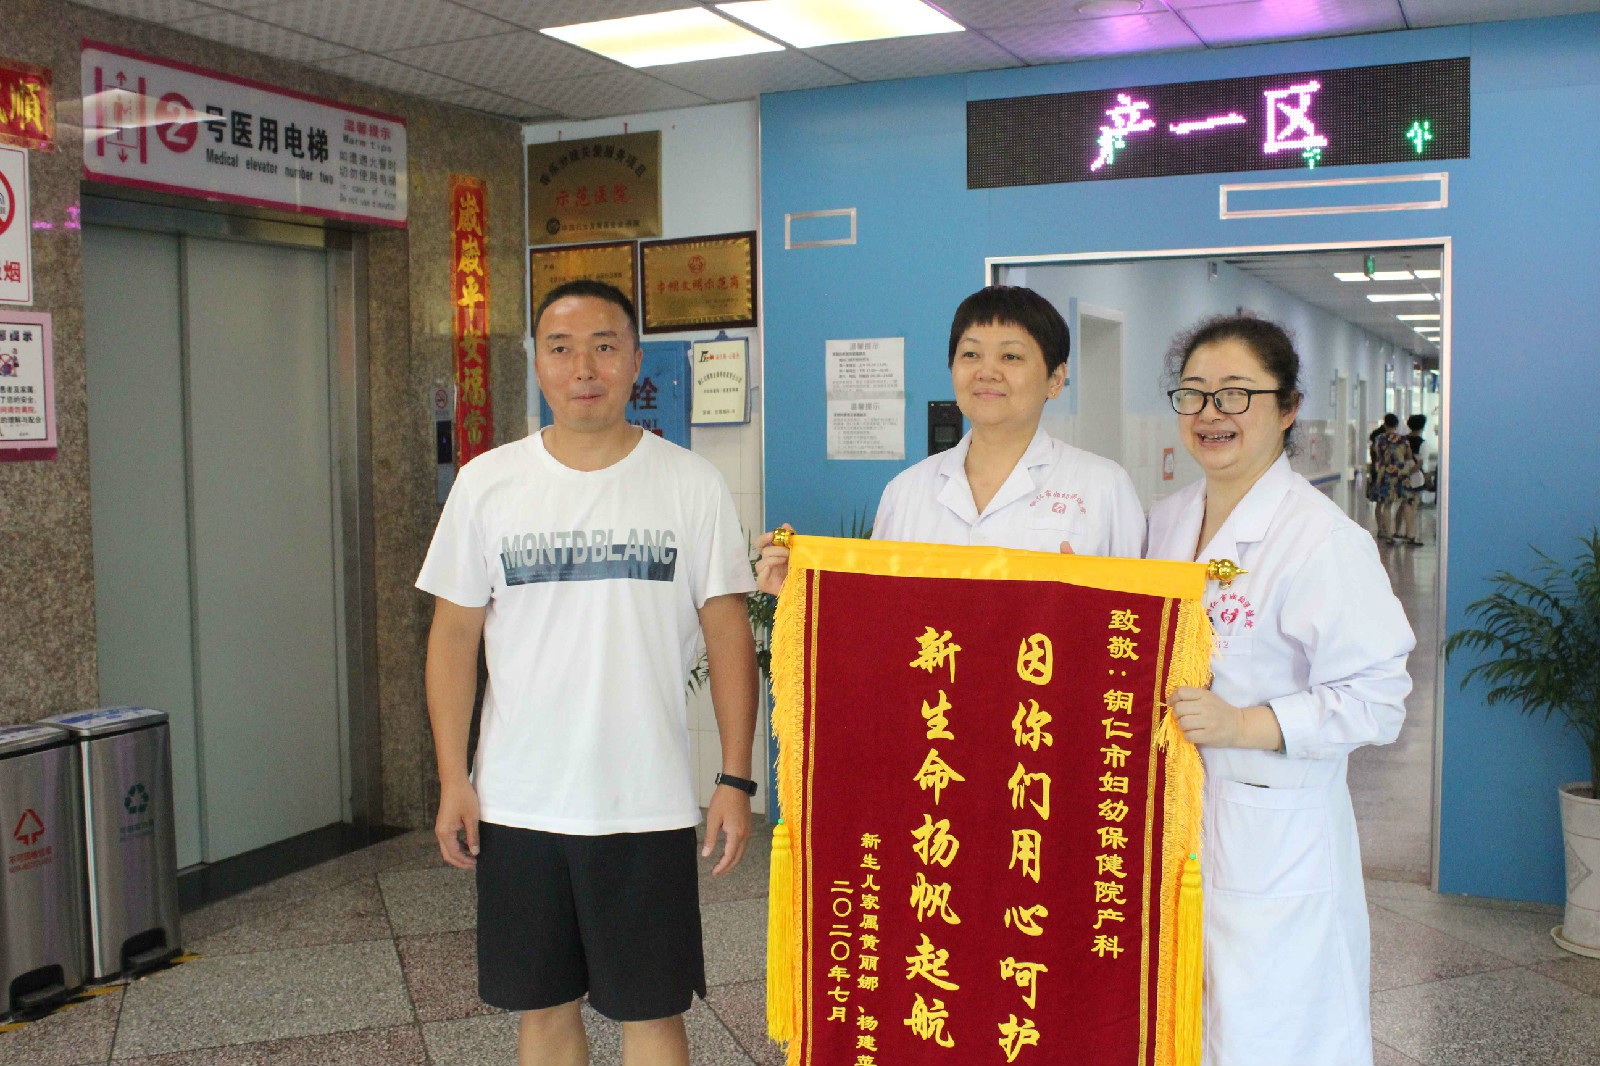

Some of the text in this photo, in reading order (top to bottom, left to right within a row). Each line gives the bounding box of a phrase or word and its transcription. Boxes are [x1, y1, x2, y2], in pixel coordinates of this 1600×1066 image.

[0, 79, 43, 131] 順
[1089, 80, 1329, 172] 产一区
[206, 148, 334, 185] Medical elevator number two
[0, 260, 21, 284] 烟
[629, 377, 658, 410] 栓
[501, 528, 676, 570] MONTDBLANC
[1090, 608, 1141, 960] 致敬：铜仁市妇幼保健院产科
[904, 625, 966, 1048] 新生命扬帆起航
[998, 632, 1053, 1063] 因你们用心呵护
